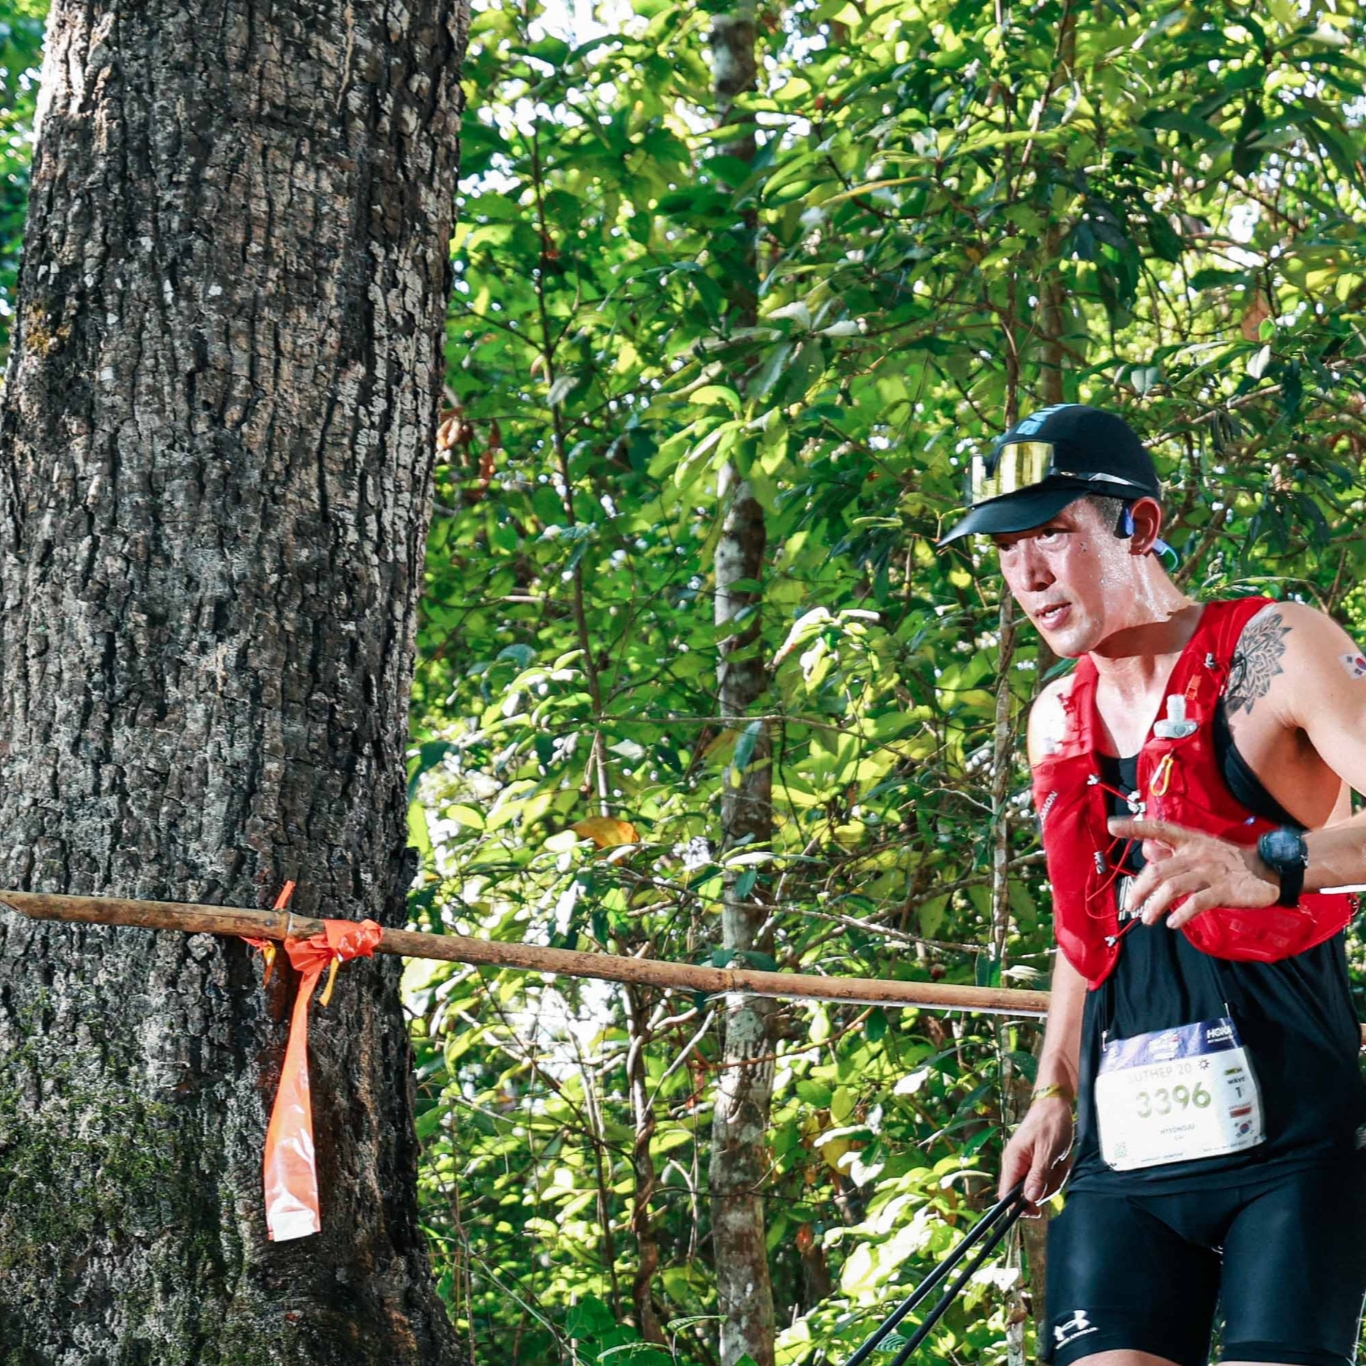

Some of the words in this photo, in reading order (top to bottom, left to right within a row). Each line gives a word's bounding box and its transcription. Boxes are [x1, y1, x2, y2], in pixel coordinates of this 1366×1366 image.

[1206, 1025, 1233, 1040] HOKA
[1177, 1062, 1192, 1076] 20
[1234, 1086, 1243, 1099] 1
[1135, 1081, 1212, 1119] 3396
